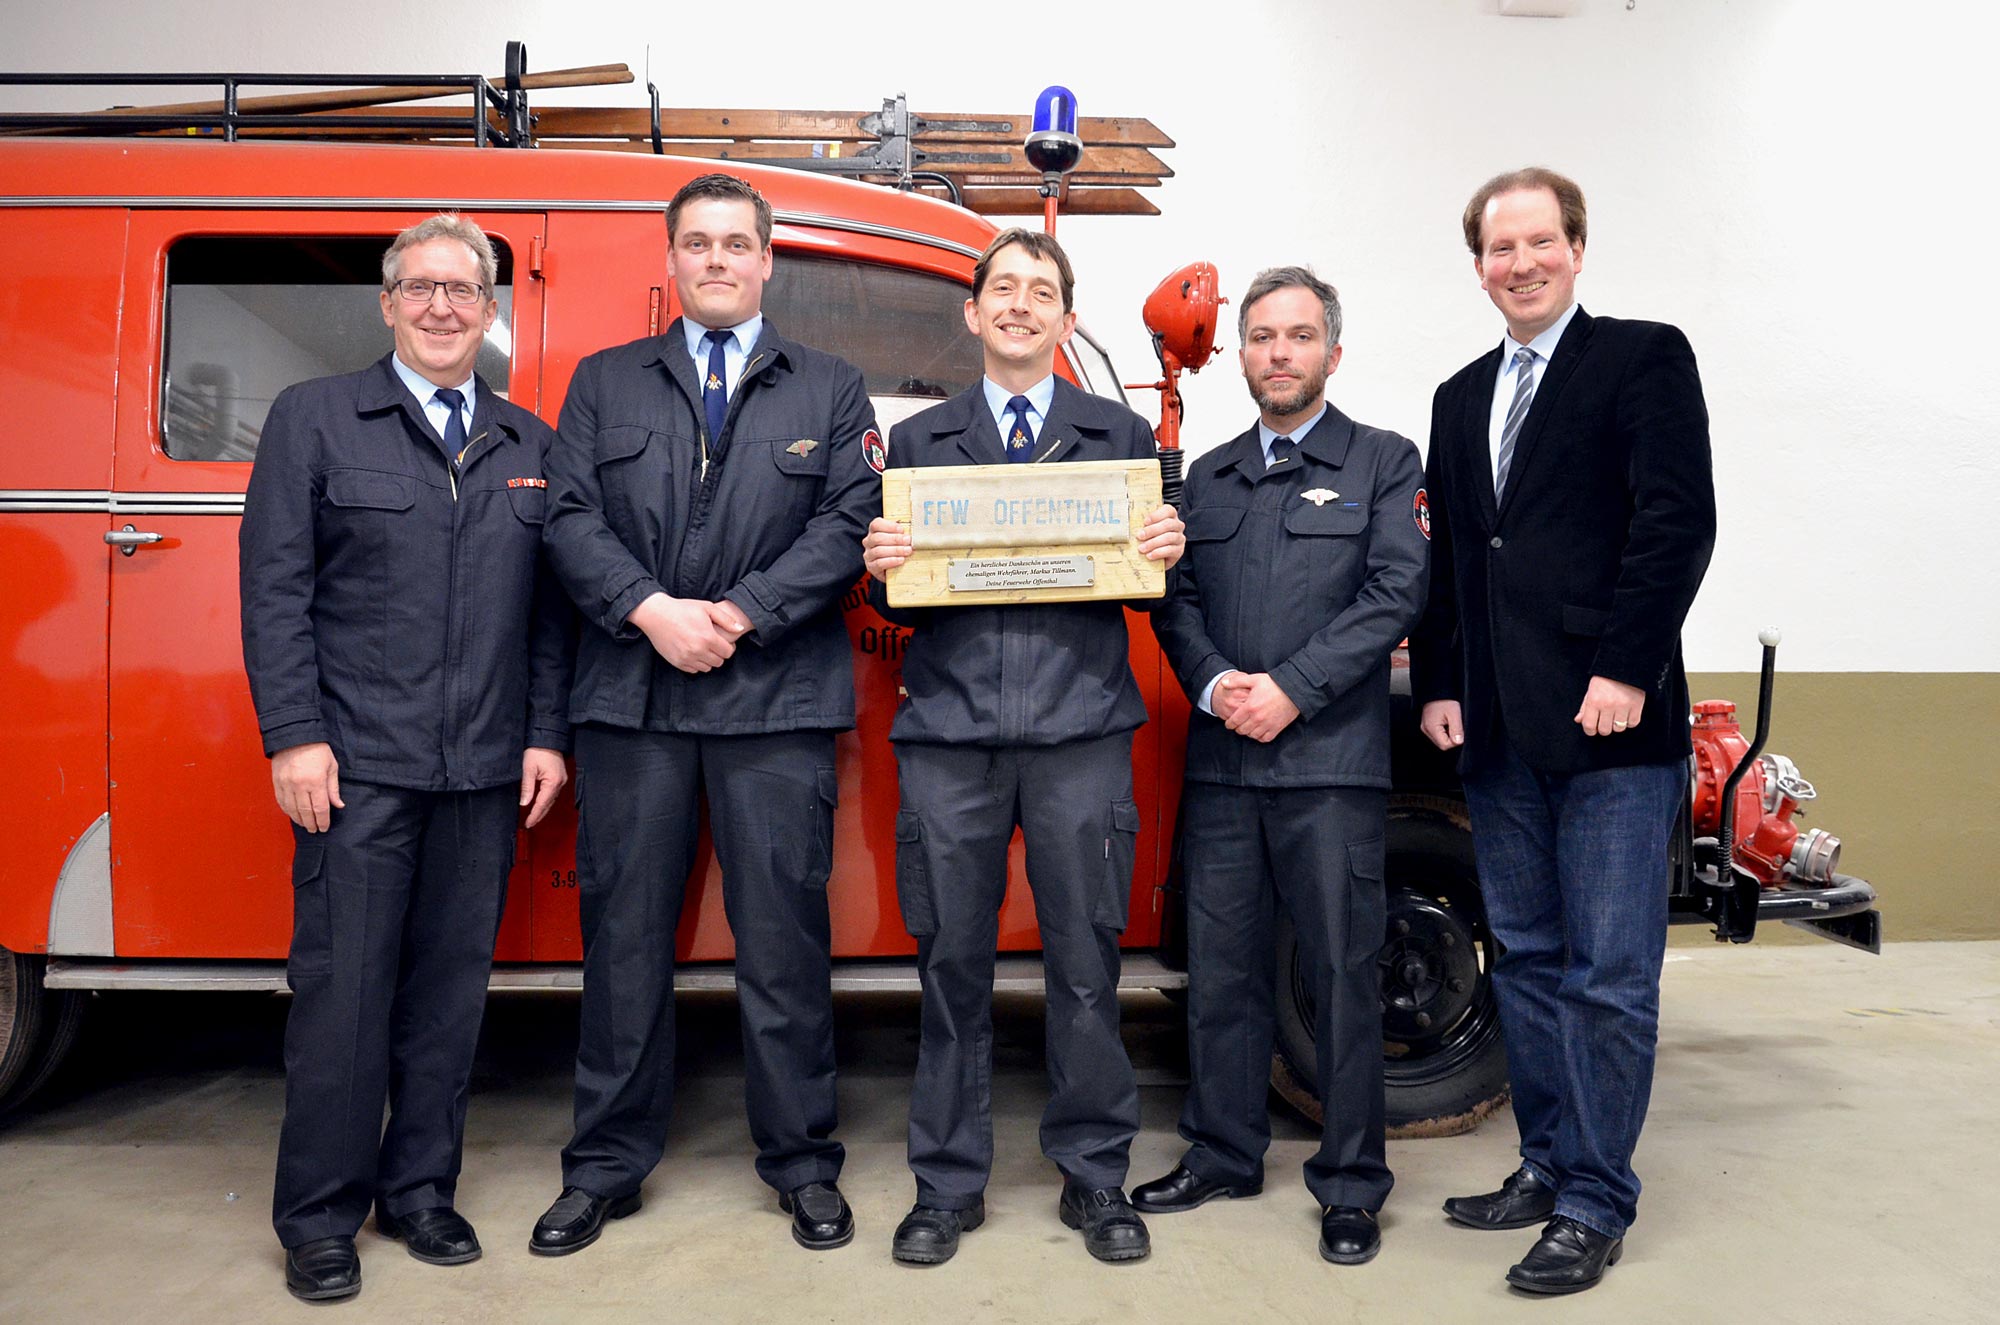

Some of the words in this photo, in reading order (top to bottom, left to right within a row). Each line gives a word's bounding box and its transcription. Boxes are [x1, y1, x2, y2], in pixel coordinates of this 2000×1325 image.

[923, 499, 970, 526] FFW
[993, 497, 1121, 526] OFFENTHAL
[966, 570, 996, 578] ehemaligen
[997, 569, 1029, 577] Wehrführer,
[1032, 578, 1058, 586] Offenthal
